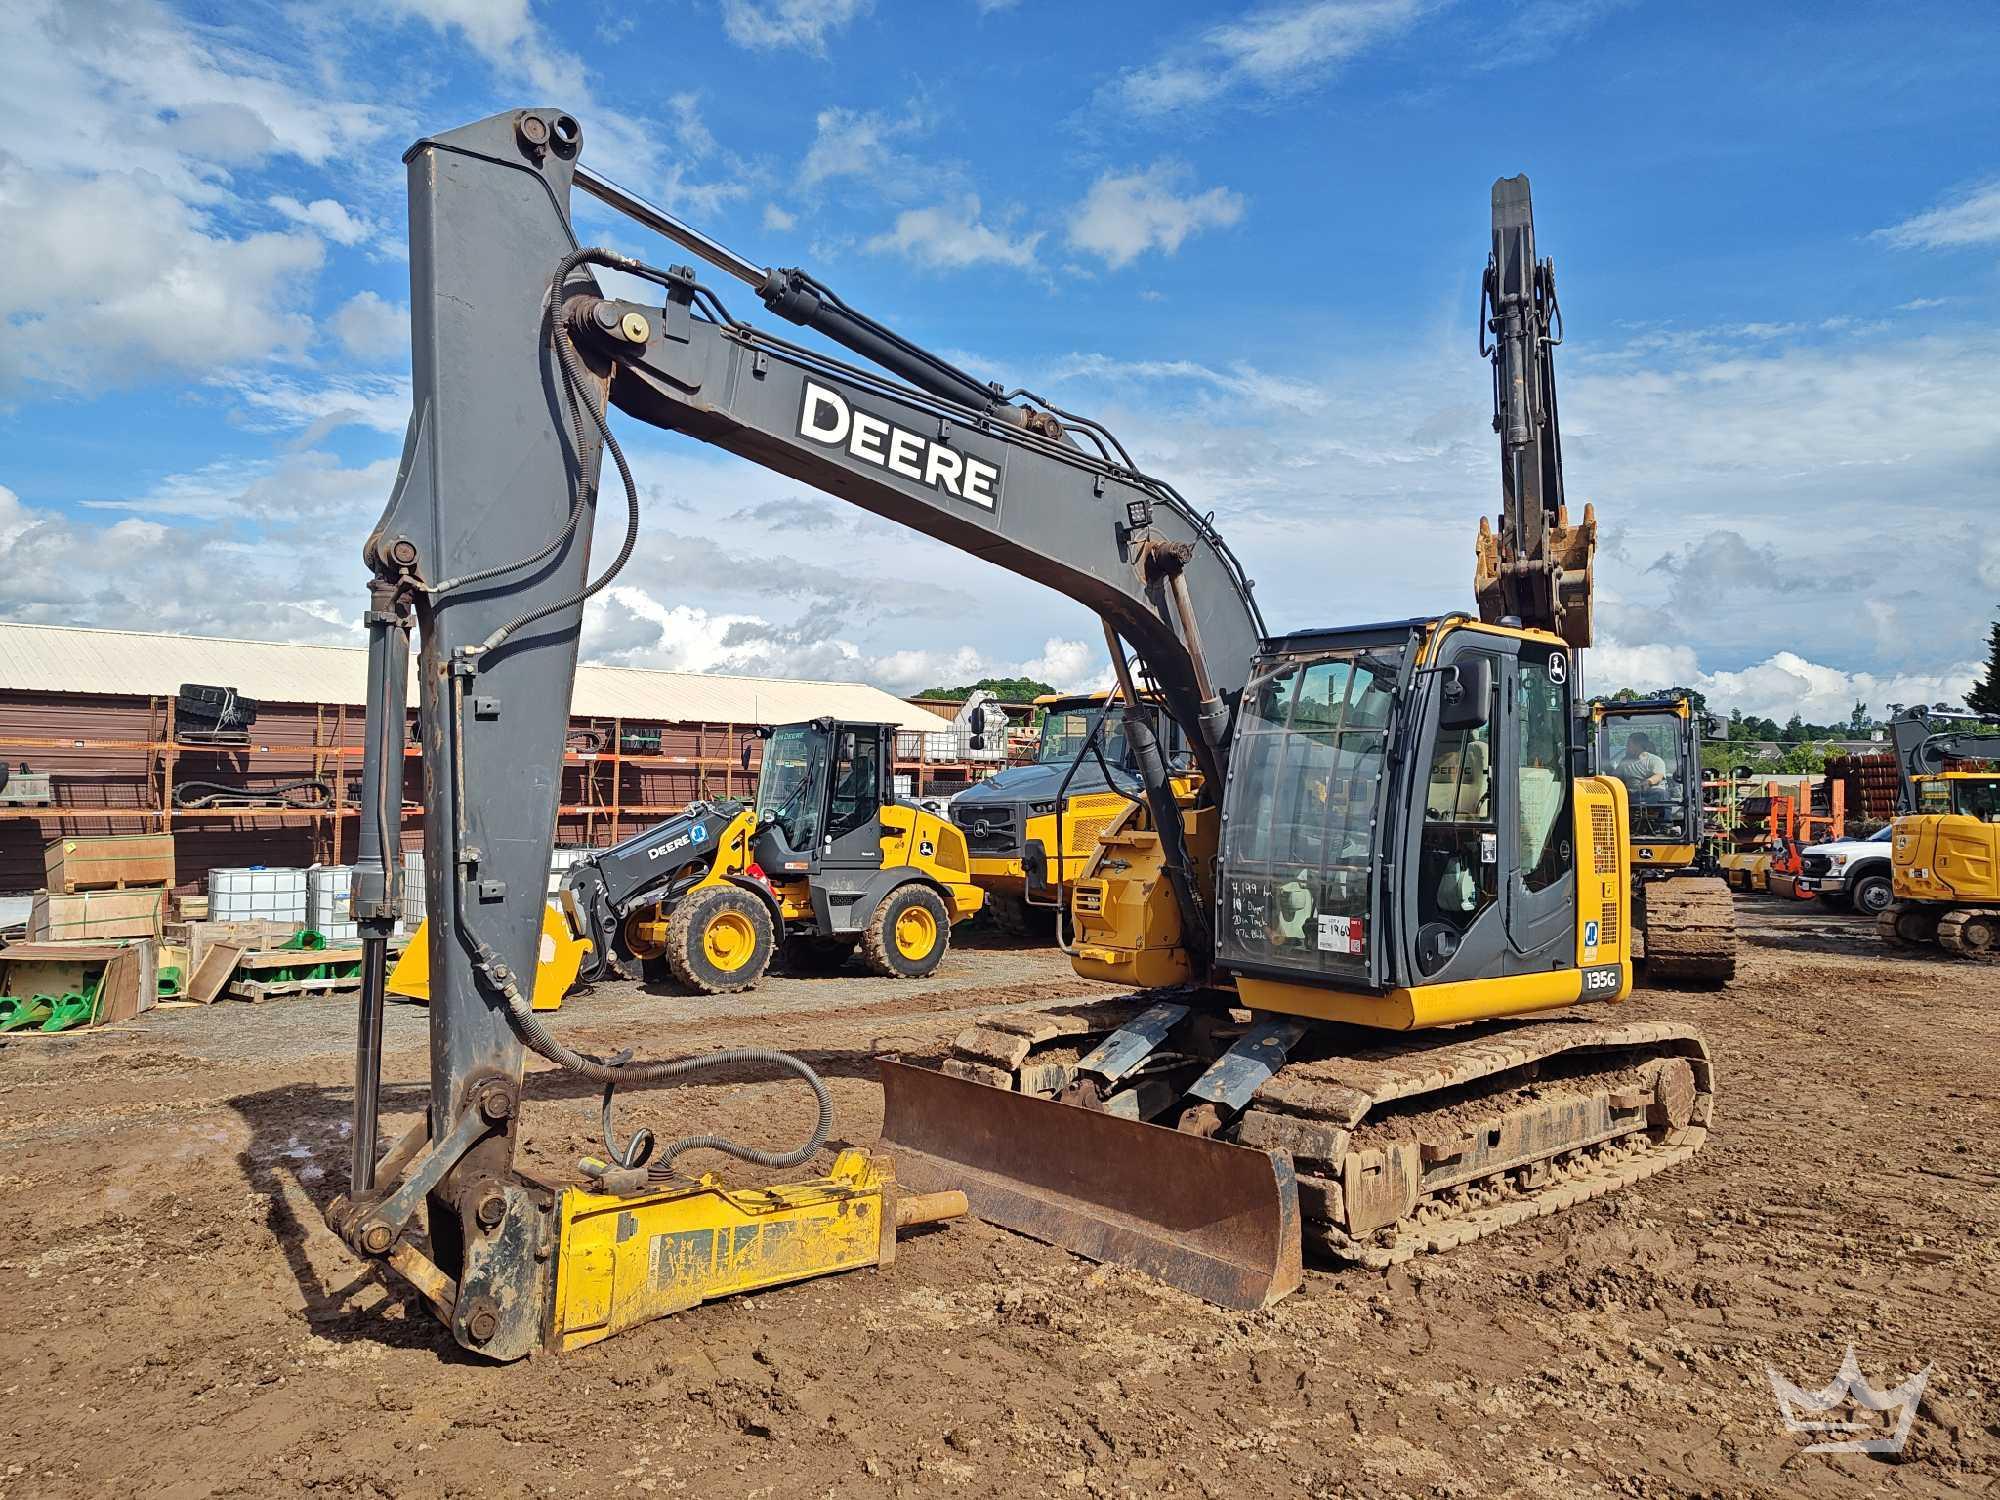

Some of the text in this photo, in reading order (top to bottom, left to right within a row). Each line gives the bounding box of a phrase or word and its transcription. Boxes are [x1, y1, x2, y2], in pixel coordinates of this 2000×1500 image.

[800, 381, 998, 509] DEERE
[648, 834, 691, 860] DEERE
[1231, 882, 1257, 897] 4,199
[1330, 924, 1350, 937] 1960
[1587, 971, 1616, 989] 135G
